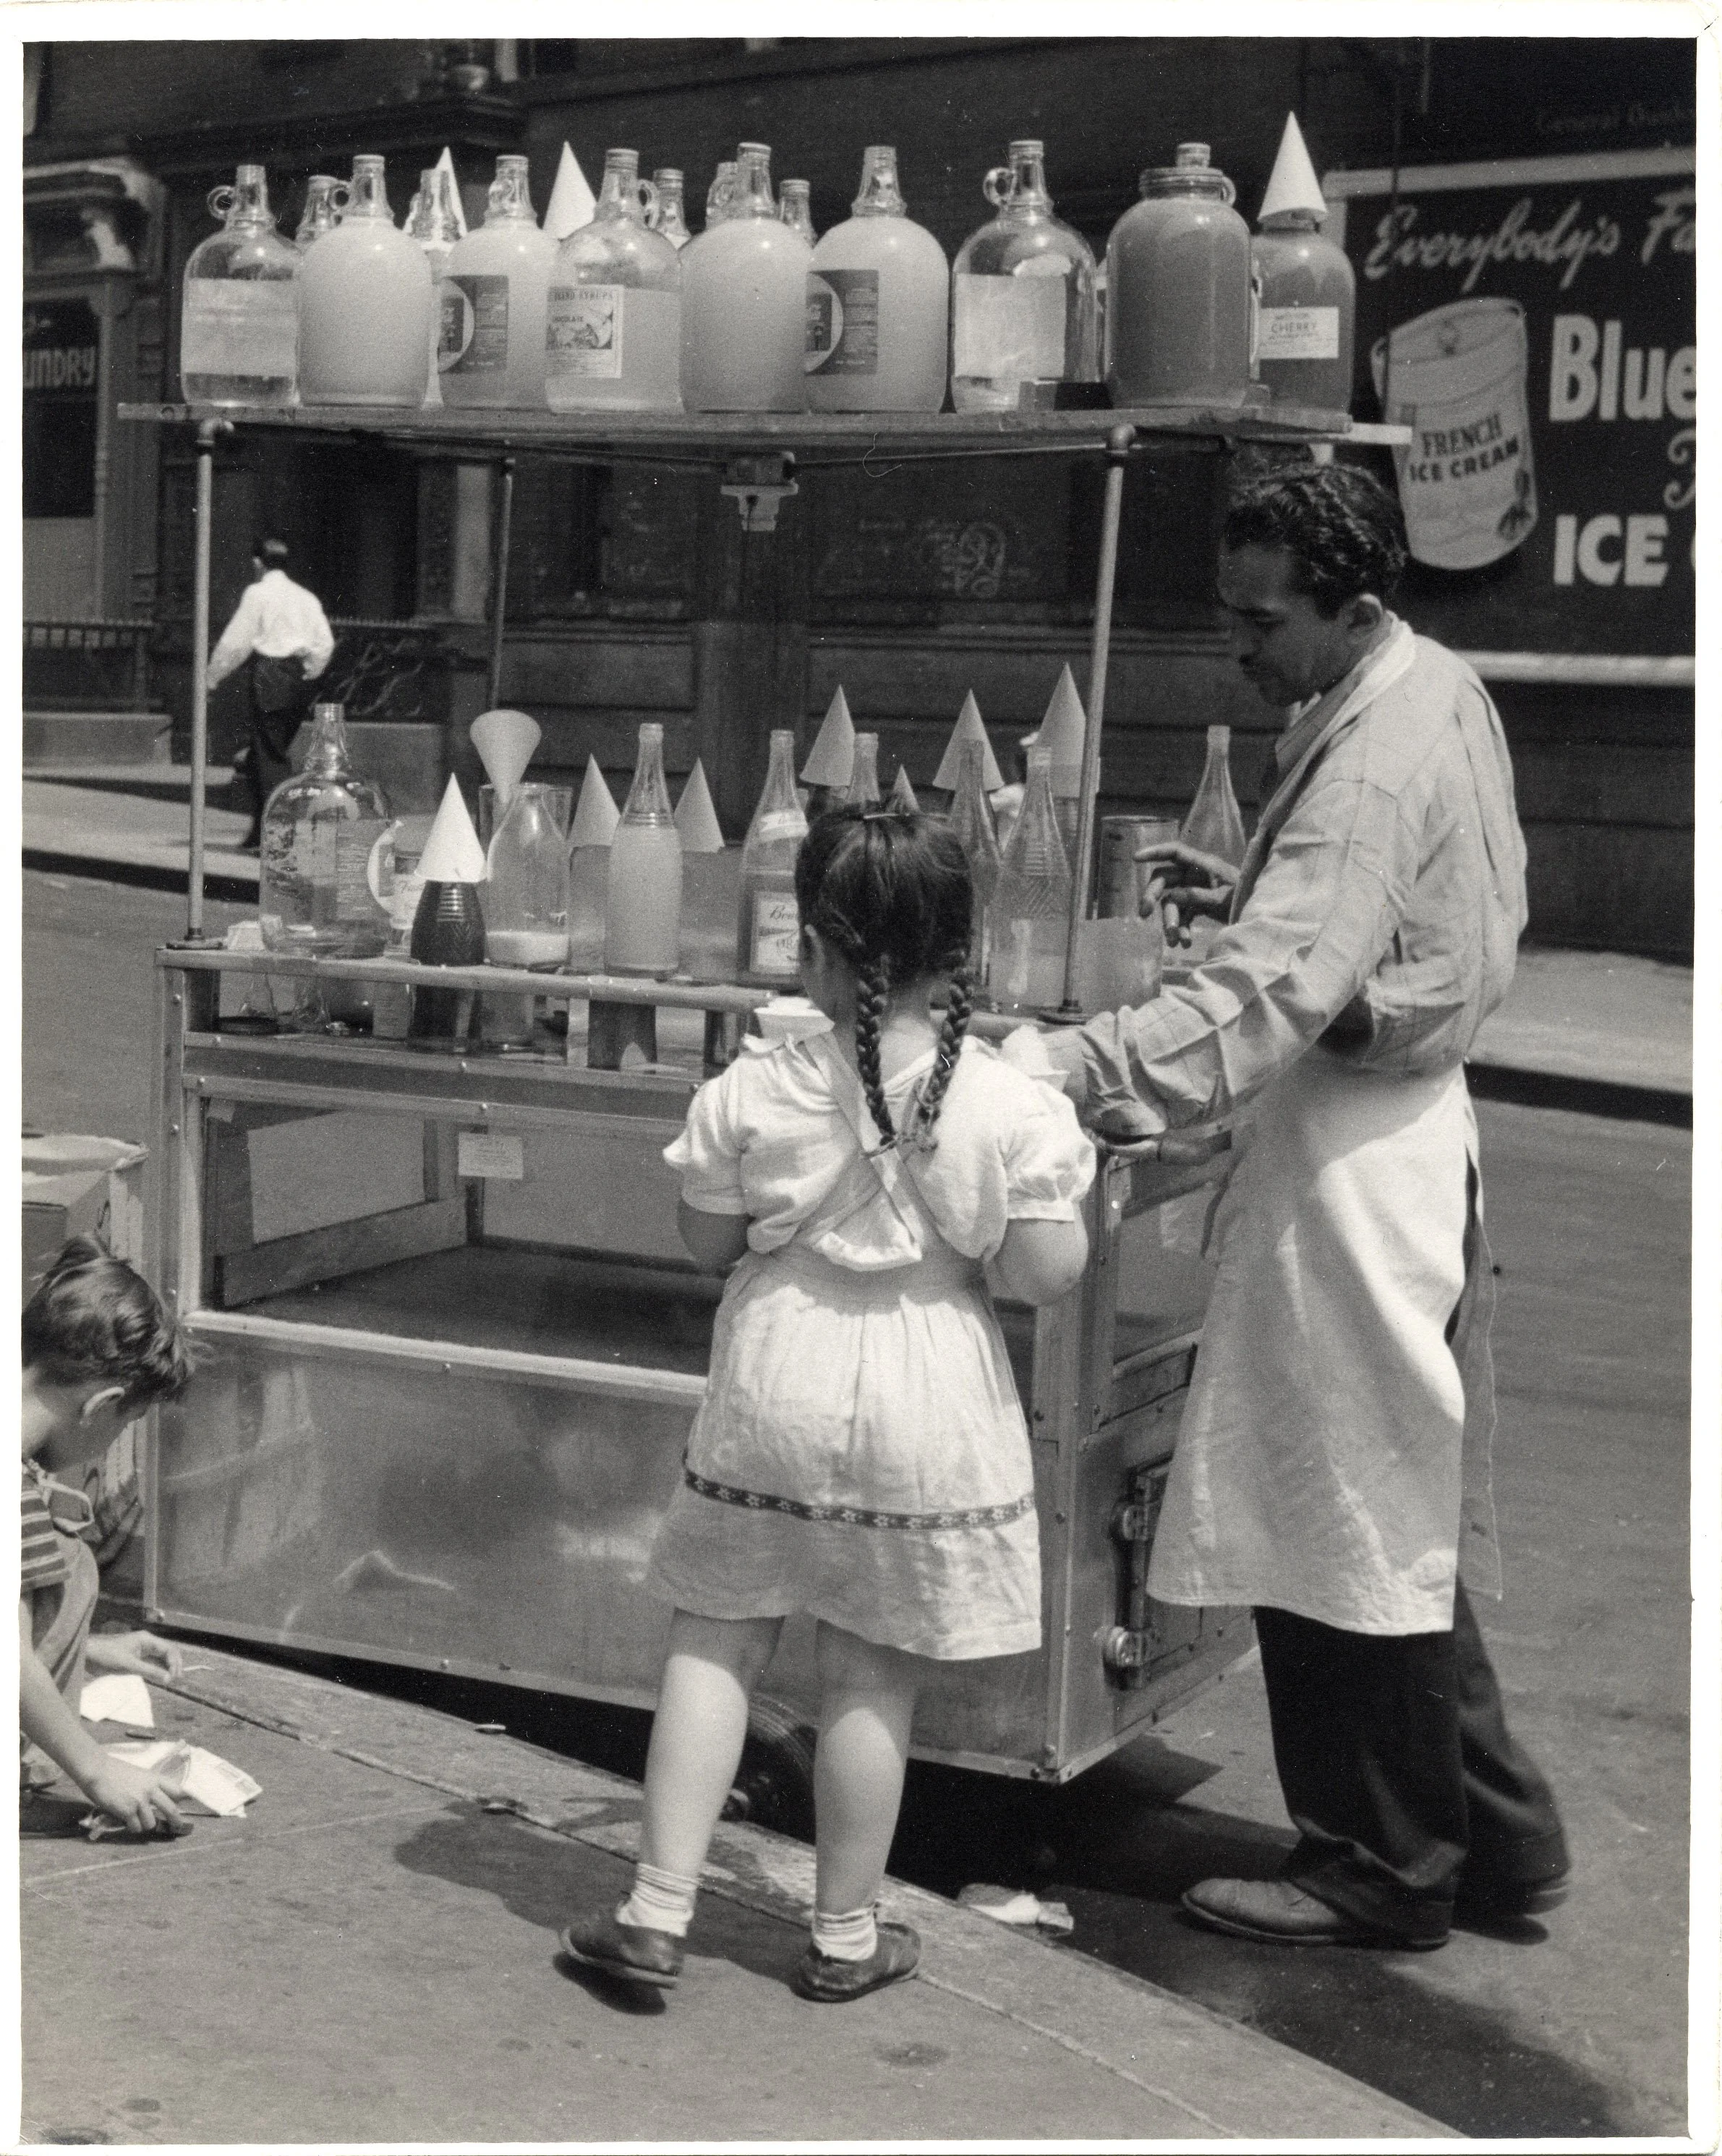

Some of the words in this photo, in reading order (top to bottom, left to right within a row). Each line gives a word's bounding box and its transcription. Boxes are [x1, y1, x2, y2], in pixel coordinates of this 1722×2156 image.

[1364, 197, 1620, 292] Everybody's
[1549, 314, 1696, 422] Blue
[1409, 461, 1444, 482] ICE
[1449, 435, 1520, 478] CREAM
[1420, 414, 1504, 458] FRENCH
[1553, 514, 1670, 587] ICE
